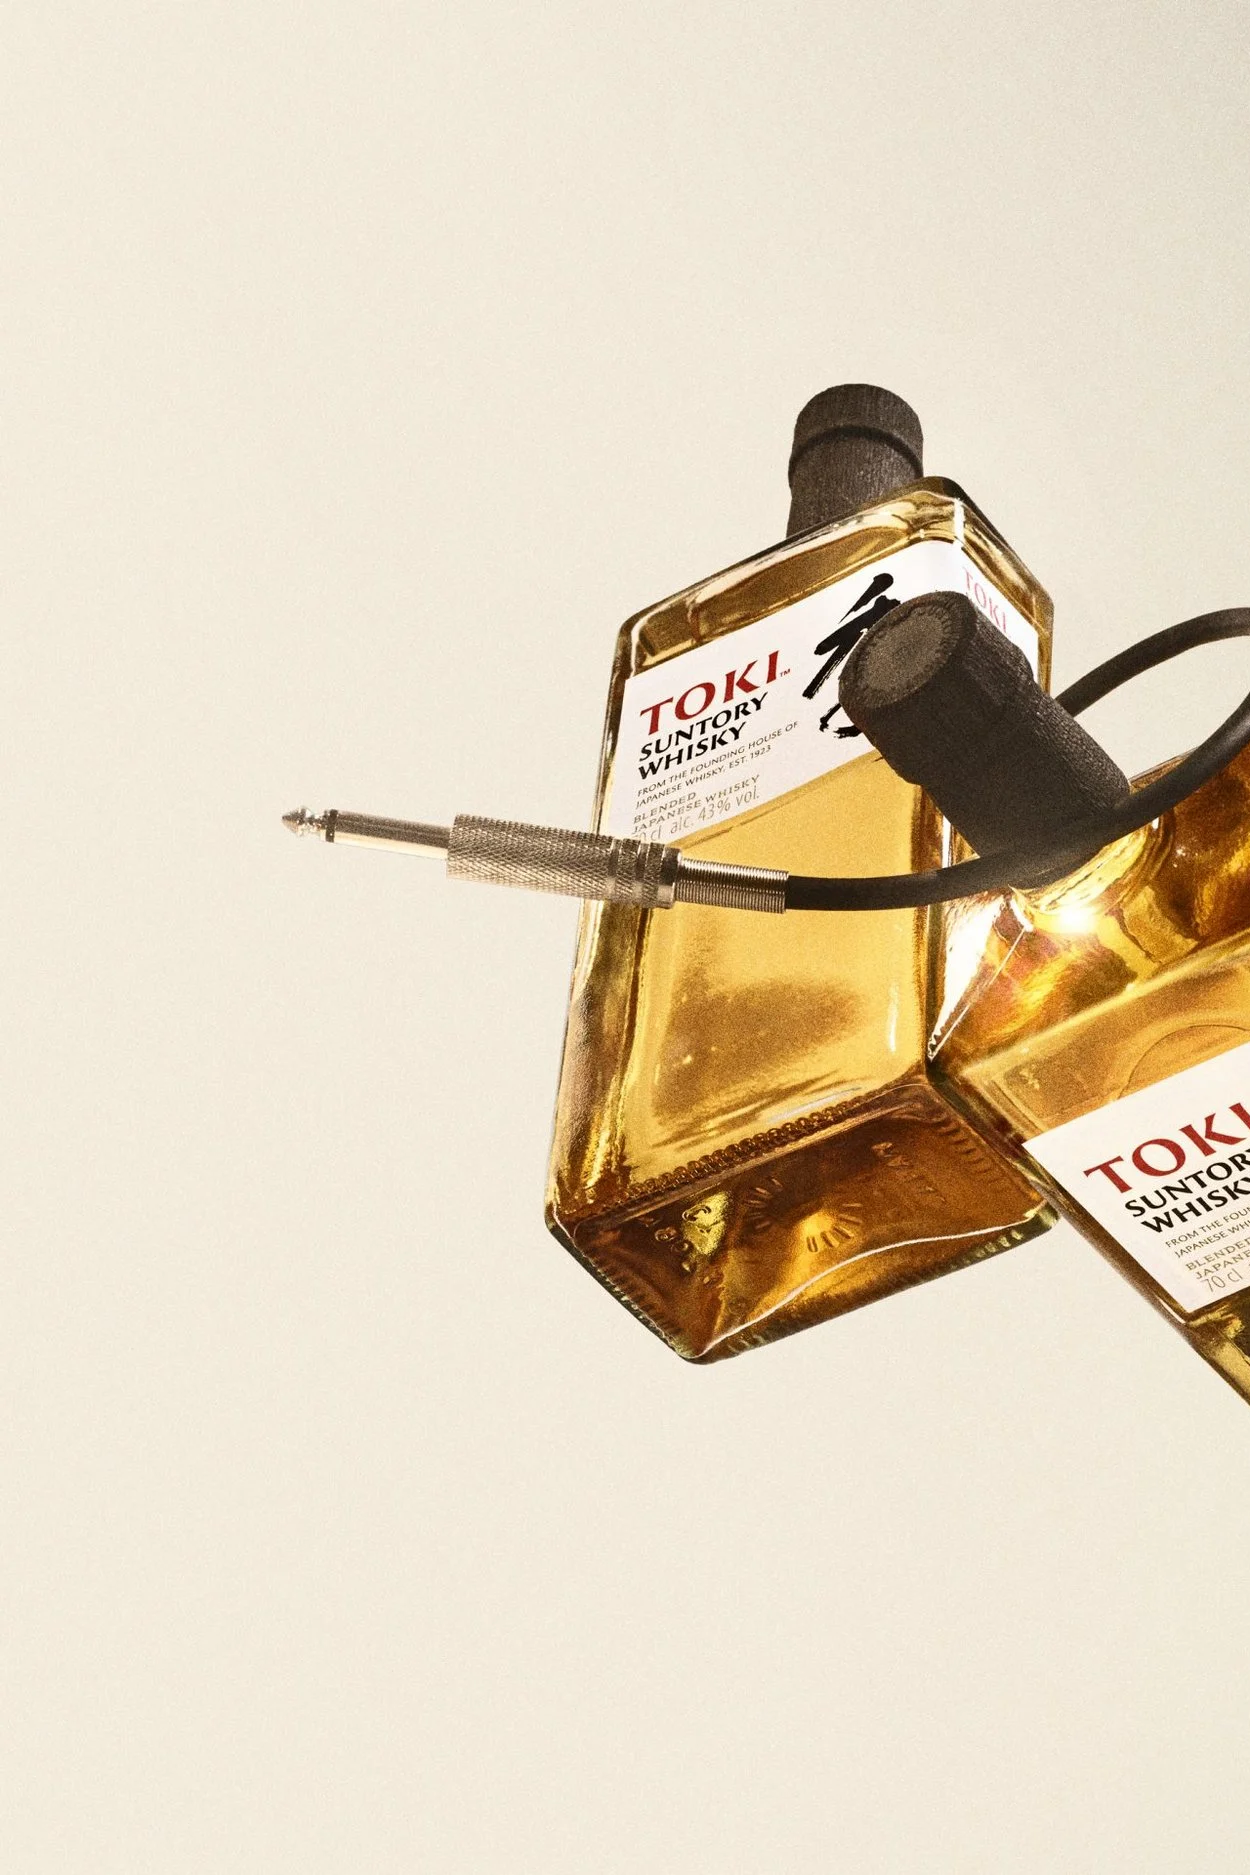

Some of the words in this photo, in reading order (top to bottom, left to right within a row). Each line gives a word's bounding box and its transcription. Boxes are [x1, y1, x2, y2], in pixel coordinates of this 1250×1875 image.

[963, 566, 1007, 634] TOKI
[640, 650, 779, 736] TOKI
[638, 722, 746, 780] WHISKY
[639, 691, 768, 762] SUNTORY
[636, 783, 682, 810] JAPANESE
[685, 766, 725, 787] WHISKY,
[729, 755, 748, 769] EST.
[750, 745, 772, 760] 1923
[637, 780, 666, 798] FROM
[668, 770, 688, 783] THE
[690, 746, 745, 775] FOUNDING
[748, 731, 782, 750] HOUSE
[785, 721, 798, 732] OF
[632, 800, 701, 835] JAPANESE
[705, 774, 760, 803] WHISKY
[633, 792, 697, 825] BLENDED
[670, 816, 694, 834] alc.
[698, 799, 731, 822] 43%
[736, 785, 760, 808] vol.
[1165, 1229, 1200, 1248] FROM
[1200, 1219, 1223, 1234] THE
[1174, 1231, 1227, 1259] JAPANESE
[1200, 1274, 1226, 1293] 70
[1227, 1268, 1243, 1284] cl
